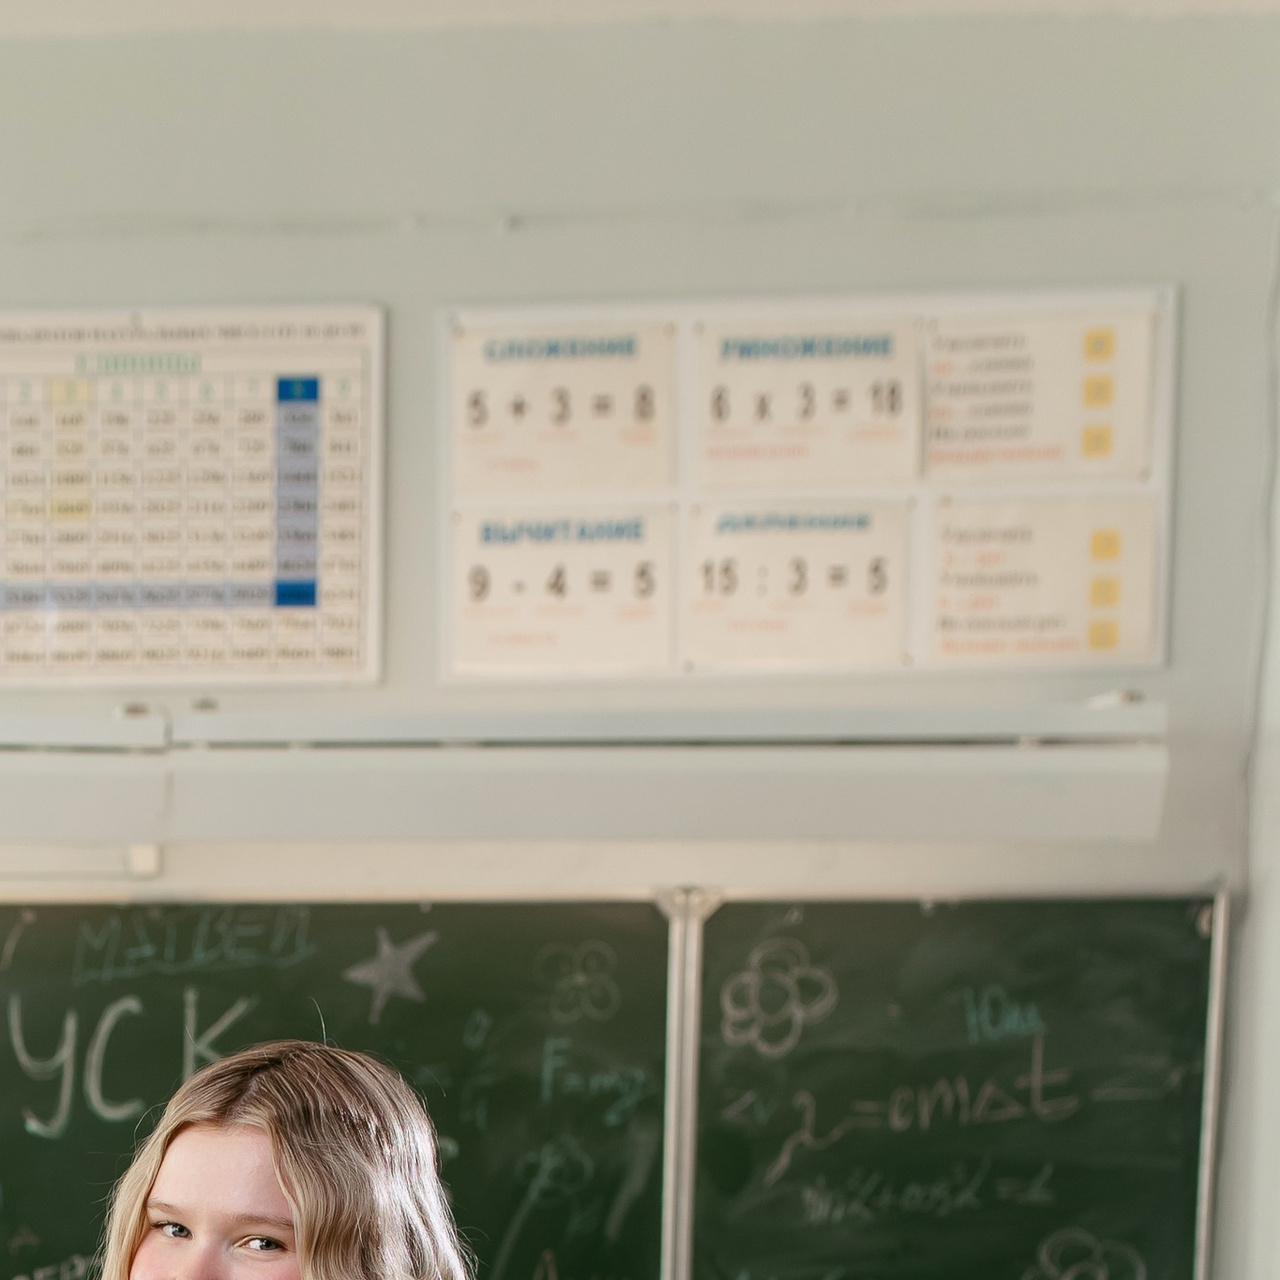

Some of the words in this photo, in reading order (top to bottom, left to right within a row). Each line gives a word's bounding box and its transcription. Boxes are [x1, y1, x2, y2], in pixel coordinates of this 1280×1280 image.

[466, 389, 489, 428] 5
[548, 387, 572, 426] 3
[632, 384, 657, 423] 8
[795, 382, 817, 421] 3
[466, 562, 490, 603] 9
[545, 562, 568, 600] 4
[632, 561, 656, 600] 5
[698, 558, 739, 598] 15
[786, 557, 808, 597] 3
[867, 557, 890, 595] 5
